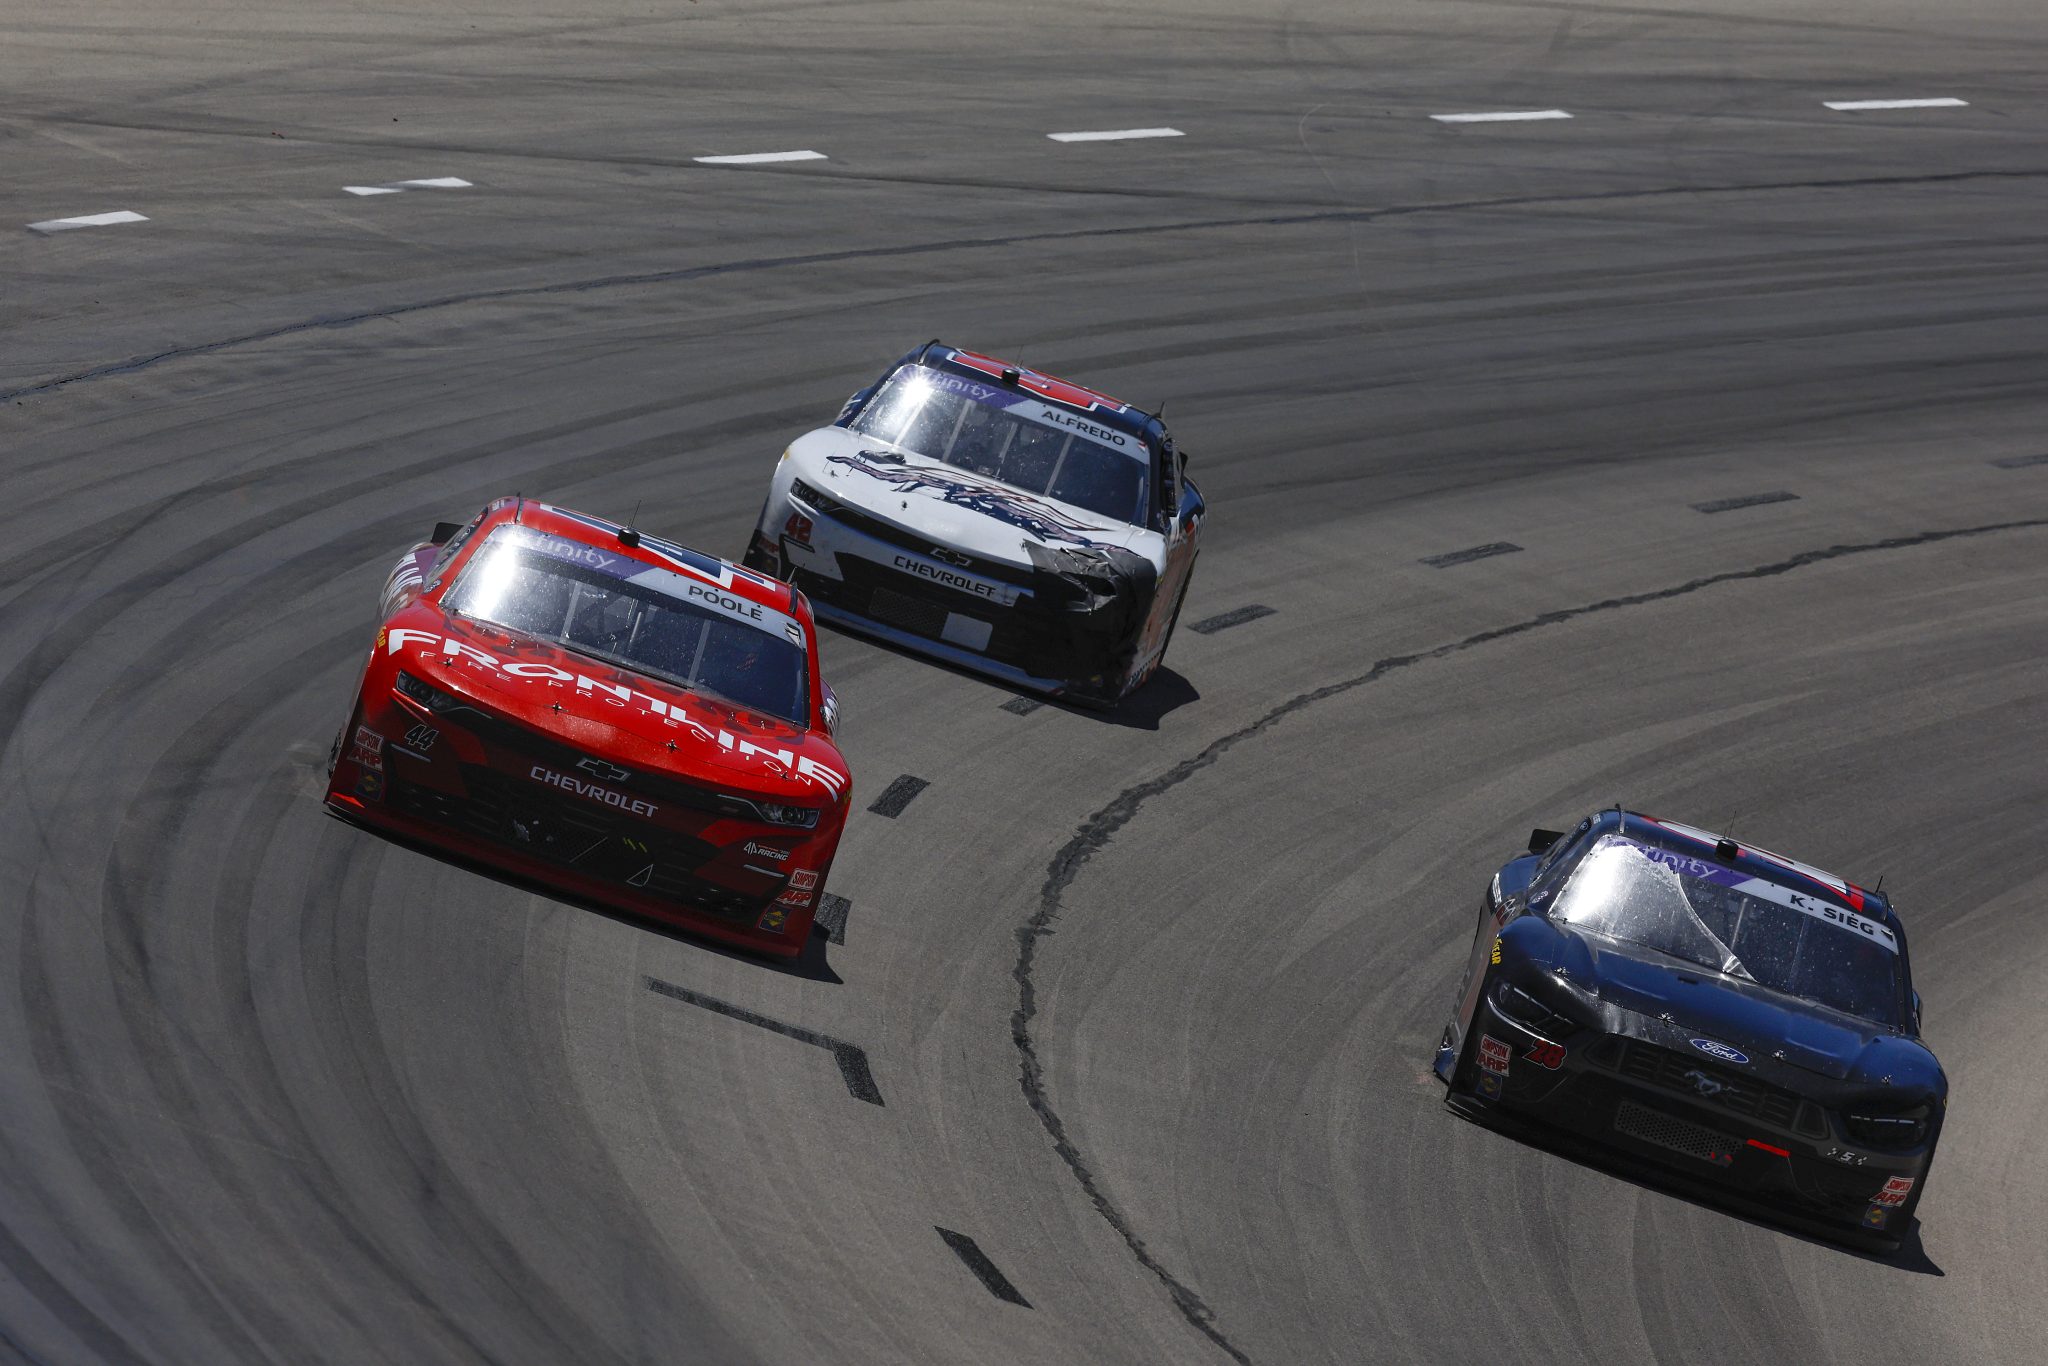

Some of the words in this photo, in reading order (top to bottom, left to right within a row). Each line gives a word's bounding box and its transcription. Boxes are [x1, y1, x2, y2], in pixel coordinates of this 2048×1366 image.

[1042, 411, 1126, 447] ALFREDO
[784, 512, 814, 545] 42
[894, 555, 997, 597] CHEVROLET
[688, 585, 763, 622] POOLE
[388, 628, 846, 803] FRONTLINE
[421, 650, 513, 683] FIRE
[547, 679, 812, 787] PROTECTION
[404, 723, 440, 751] 44
[529, 765, 660, 819] CHEVROLET
[757, 848, 790, 862] RACING
[1789, 894, 1814, 911] K.
[1823, 907, 1875, 936] SIEG
[1476, 1051, 1509, 1074] ARP
[1481, 1037, 1511, 1061] SIMPSON
[1521, 1037, 1568, 1071] 28
[1701, 1042, 1738, 1060] Ford
